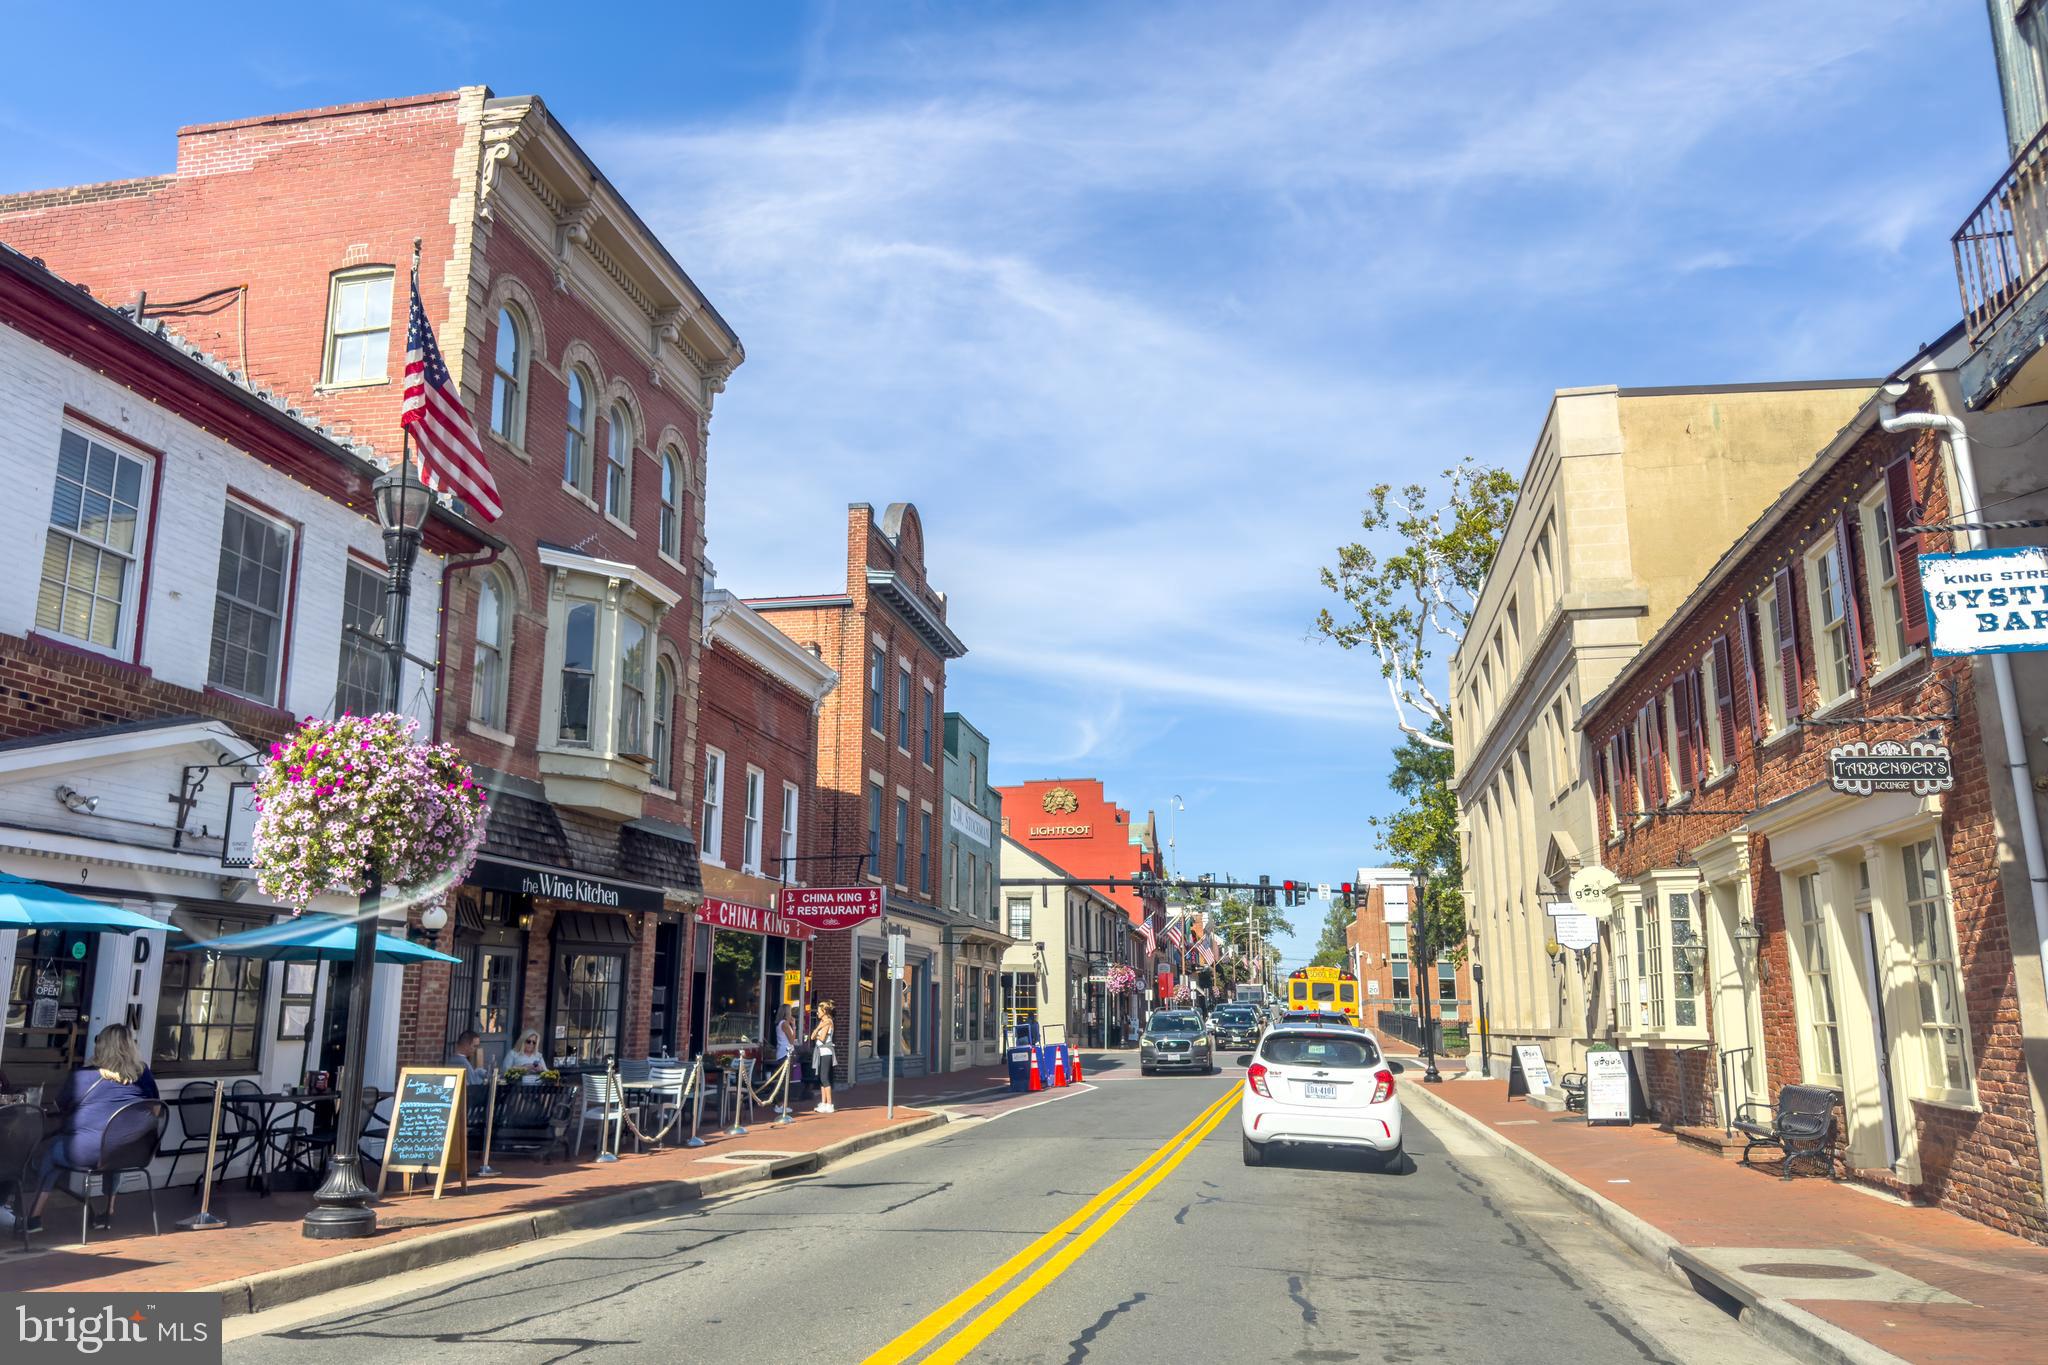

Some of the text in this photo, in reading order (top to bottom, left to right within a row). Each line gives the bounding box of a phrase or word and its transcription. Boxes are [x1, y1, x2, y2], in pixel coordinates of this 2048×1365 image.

[1944, 569, 2048, 584] KING STRE
[1836, 761, 1947, 776] TARBENDER'S
[1875, 781, 1910, 790] LOUNGE
[1030, 825, 1090, 836] LIGHTFOOT
[81, 868, 88, 884] 9
[522, 872, 619, 906] the Wine Kitchen
[802, 893, 834, 903] CHINA
[837, 892, 862, 902] KING
[797, 905, 866, 916] RESTAURANT
[719, 902, 758, 930] CHINA
[763, 911, 790, 935] KING
[36, 986, 60, 996] OPEN
